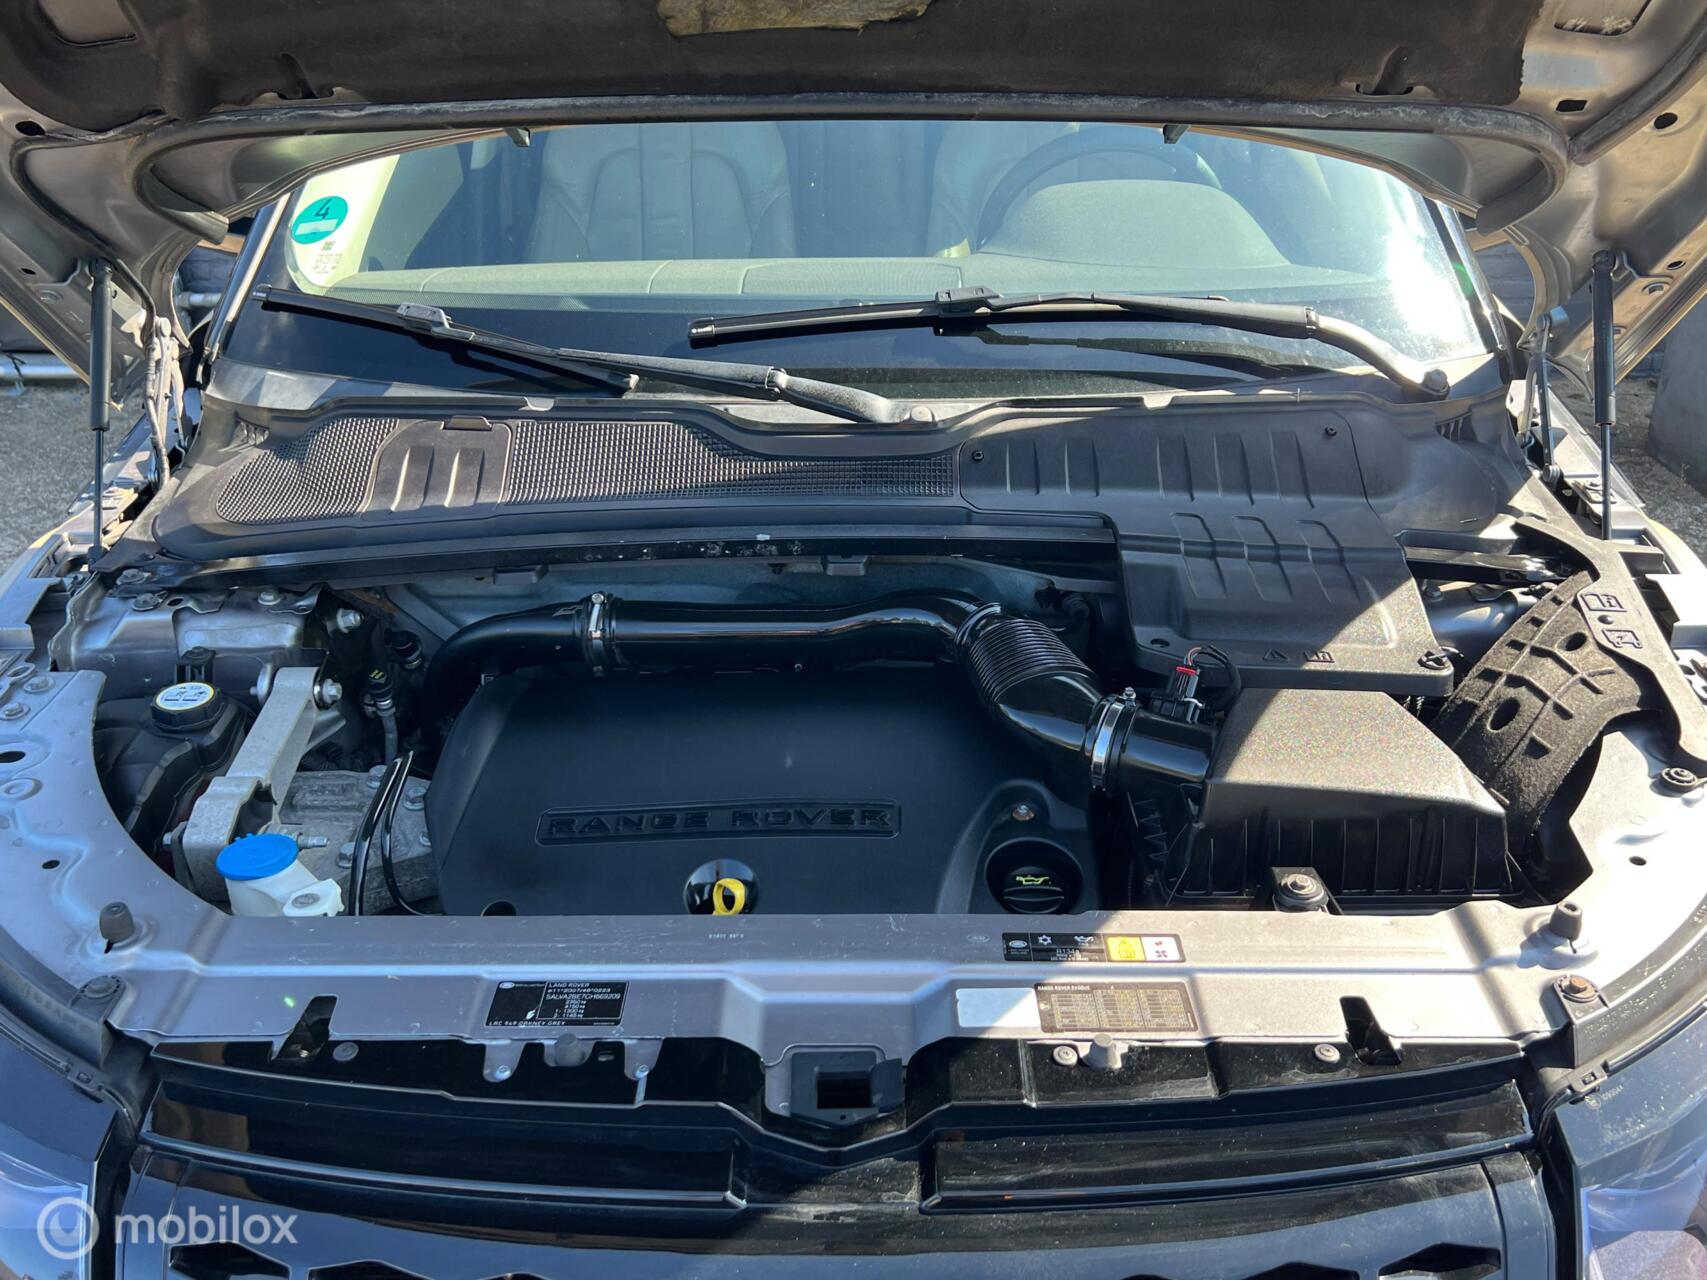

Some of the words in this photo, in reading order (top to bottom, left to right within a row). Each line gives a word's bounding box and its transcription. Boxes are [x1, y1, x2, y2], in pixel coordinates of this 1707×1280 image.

[314, 198, 332, 219] 4
[549, 811, 711, 835] RANGE
[731, 808, 891, 829] ROVER
